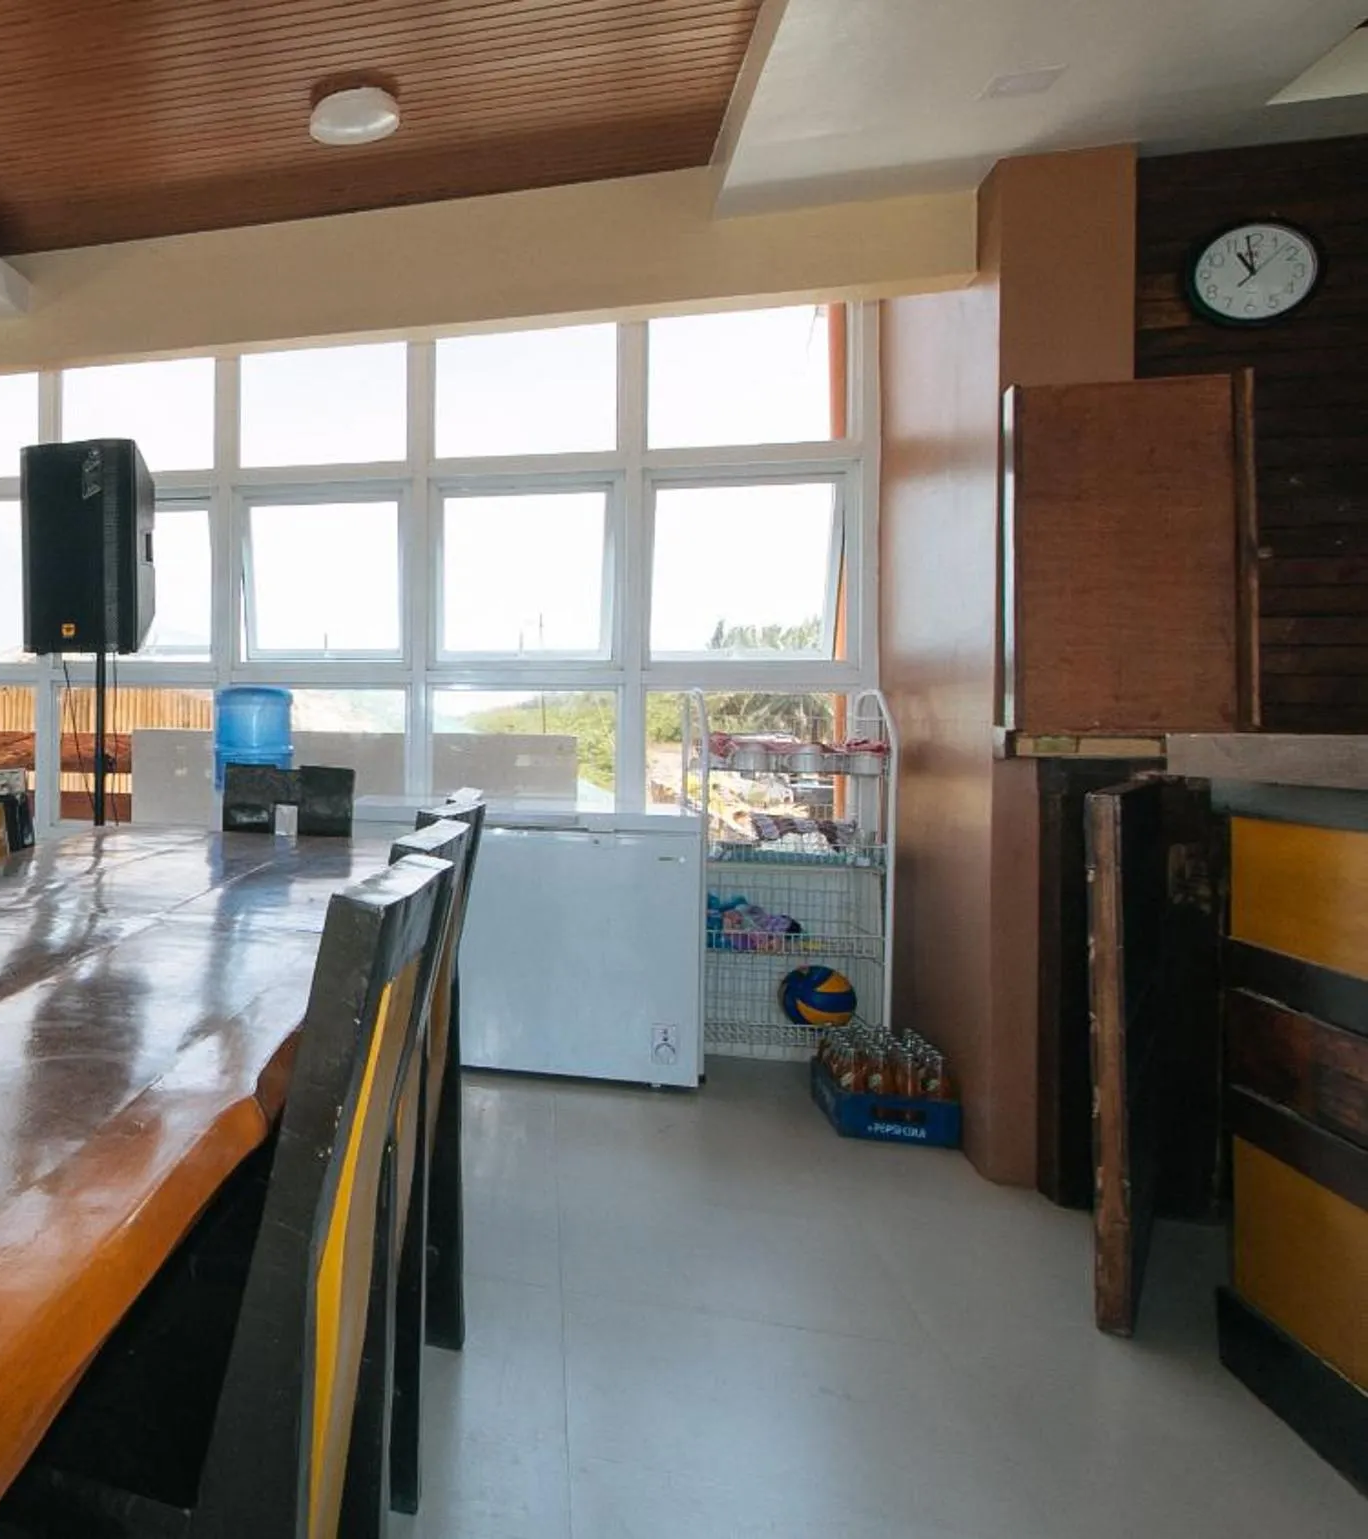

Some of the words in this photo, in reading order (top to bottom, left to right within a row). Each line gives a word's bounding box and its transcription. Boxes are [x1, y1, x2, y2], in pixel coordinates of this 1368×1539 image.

[1227, 239, 1238, 253] 11
[1272, 236, 1279, 248] 1
[1285, 246, 1300, 261] 2
[1293, 262, 1306, 279] 3
[1206, 284, 1218, 301] 8
[1284, 280, 1294, 294] 4
[1223, 296, 1233, 309] 7
[1244, 300, 1257, 314] 6
[1268, 293, 1281, 309] 5
